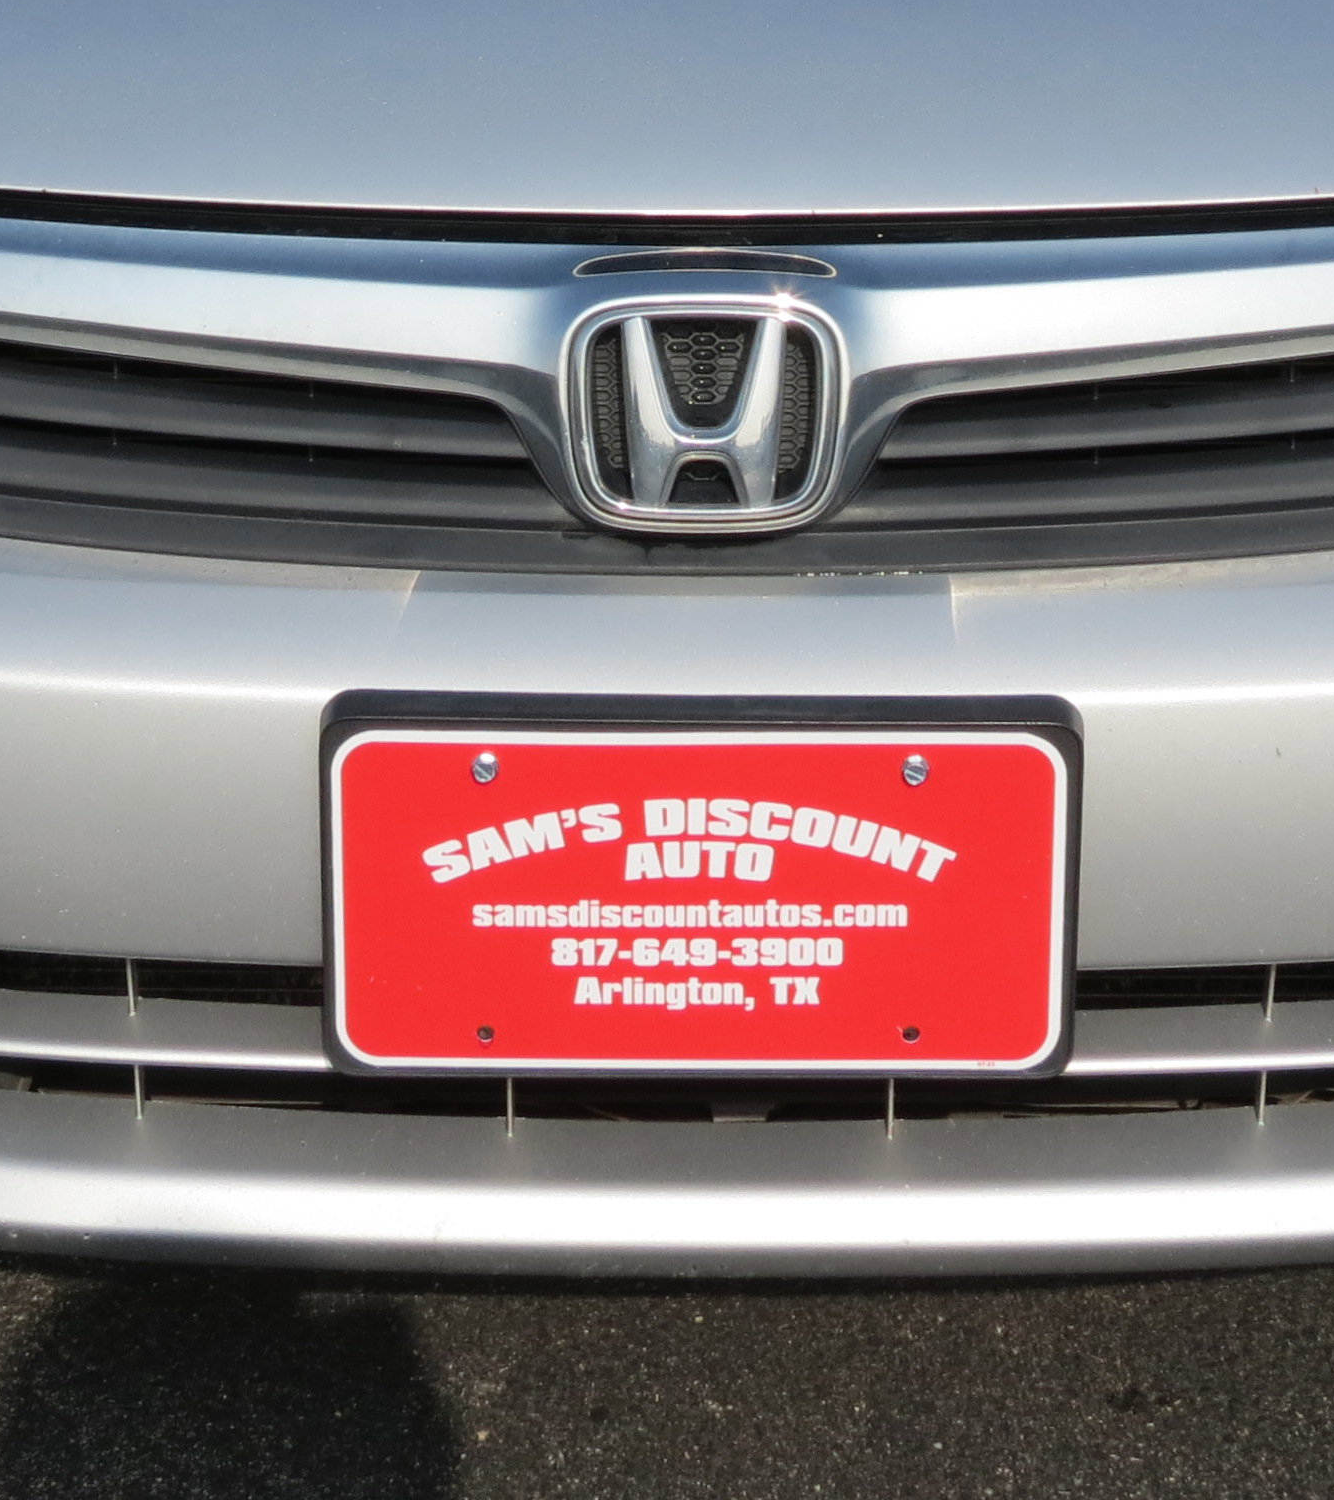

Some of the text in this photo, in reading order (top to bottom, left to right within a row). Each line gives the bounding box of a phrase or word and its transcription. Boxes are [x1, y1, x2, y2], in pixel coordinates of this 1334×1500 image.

[422, 797, 957, 884] SAM'S DISCOUNT
[624, 840, 775, 882] AUTO
[472, 898, 908, 928] samsdiscountautos.com
[551, 937, 844, 967] 817-649-3900
[573, 976, 820, 1012] Arlington, TX
